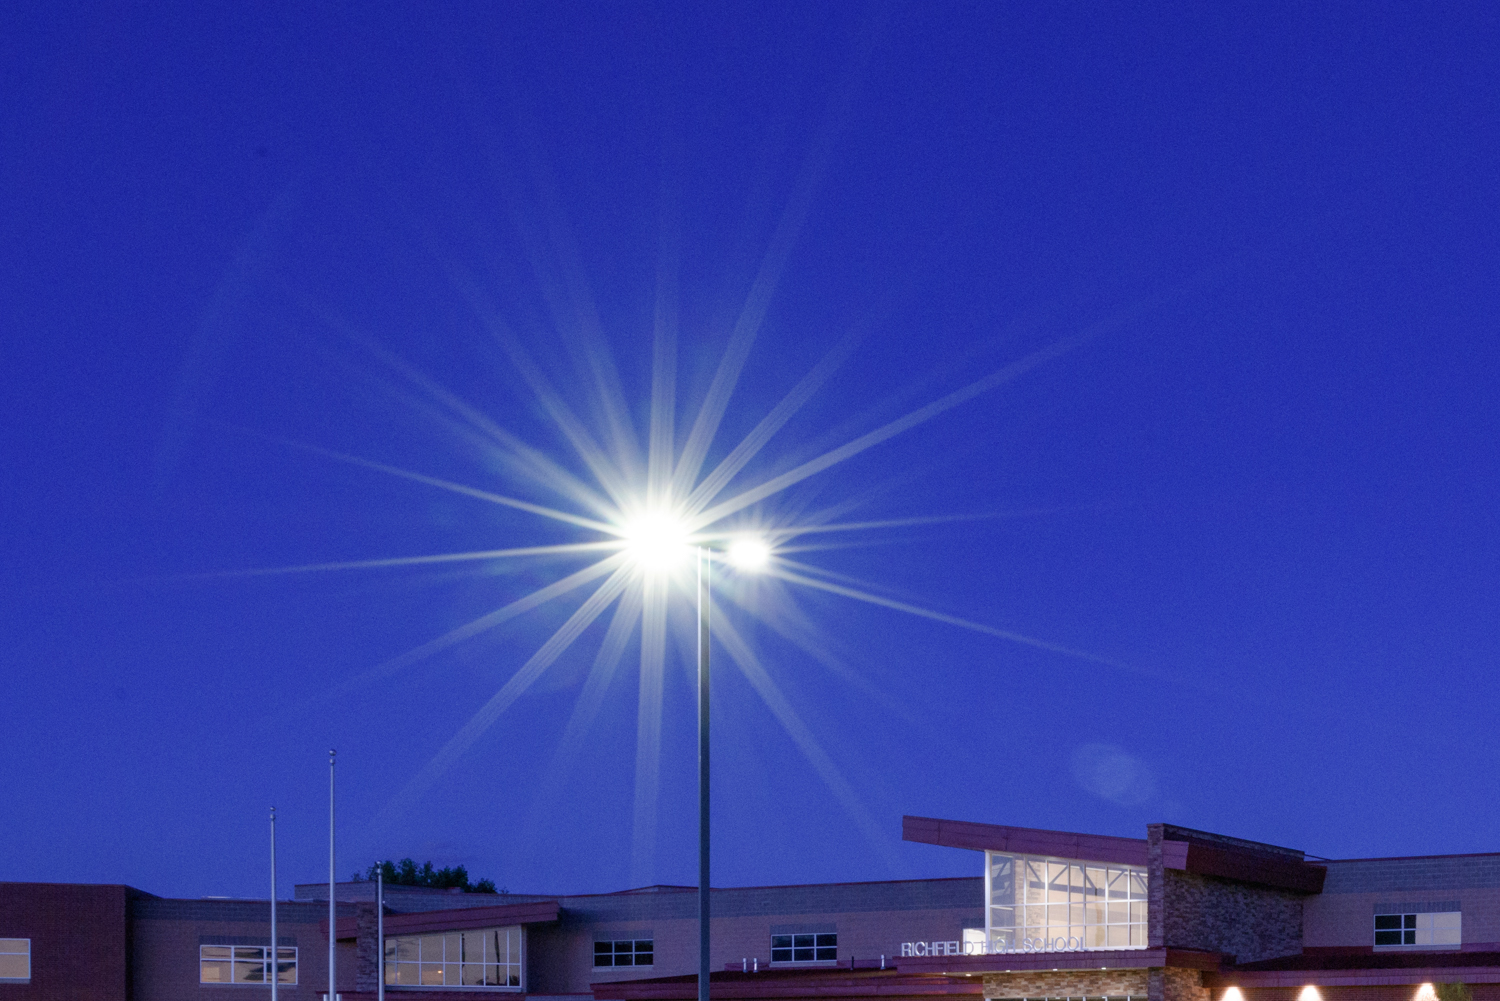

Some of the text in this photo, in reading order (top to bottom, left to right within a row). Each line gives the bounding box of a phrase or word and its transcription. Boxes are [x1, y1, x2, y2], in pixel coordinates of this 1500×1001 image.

[901, 936, 1089, 957] RICHFIELD HIGH SCHOOL
